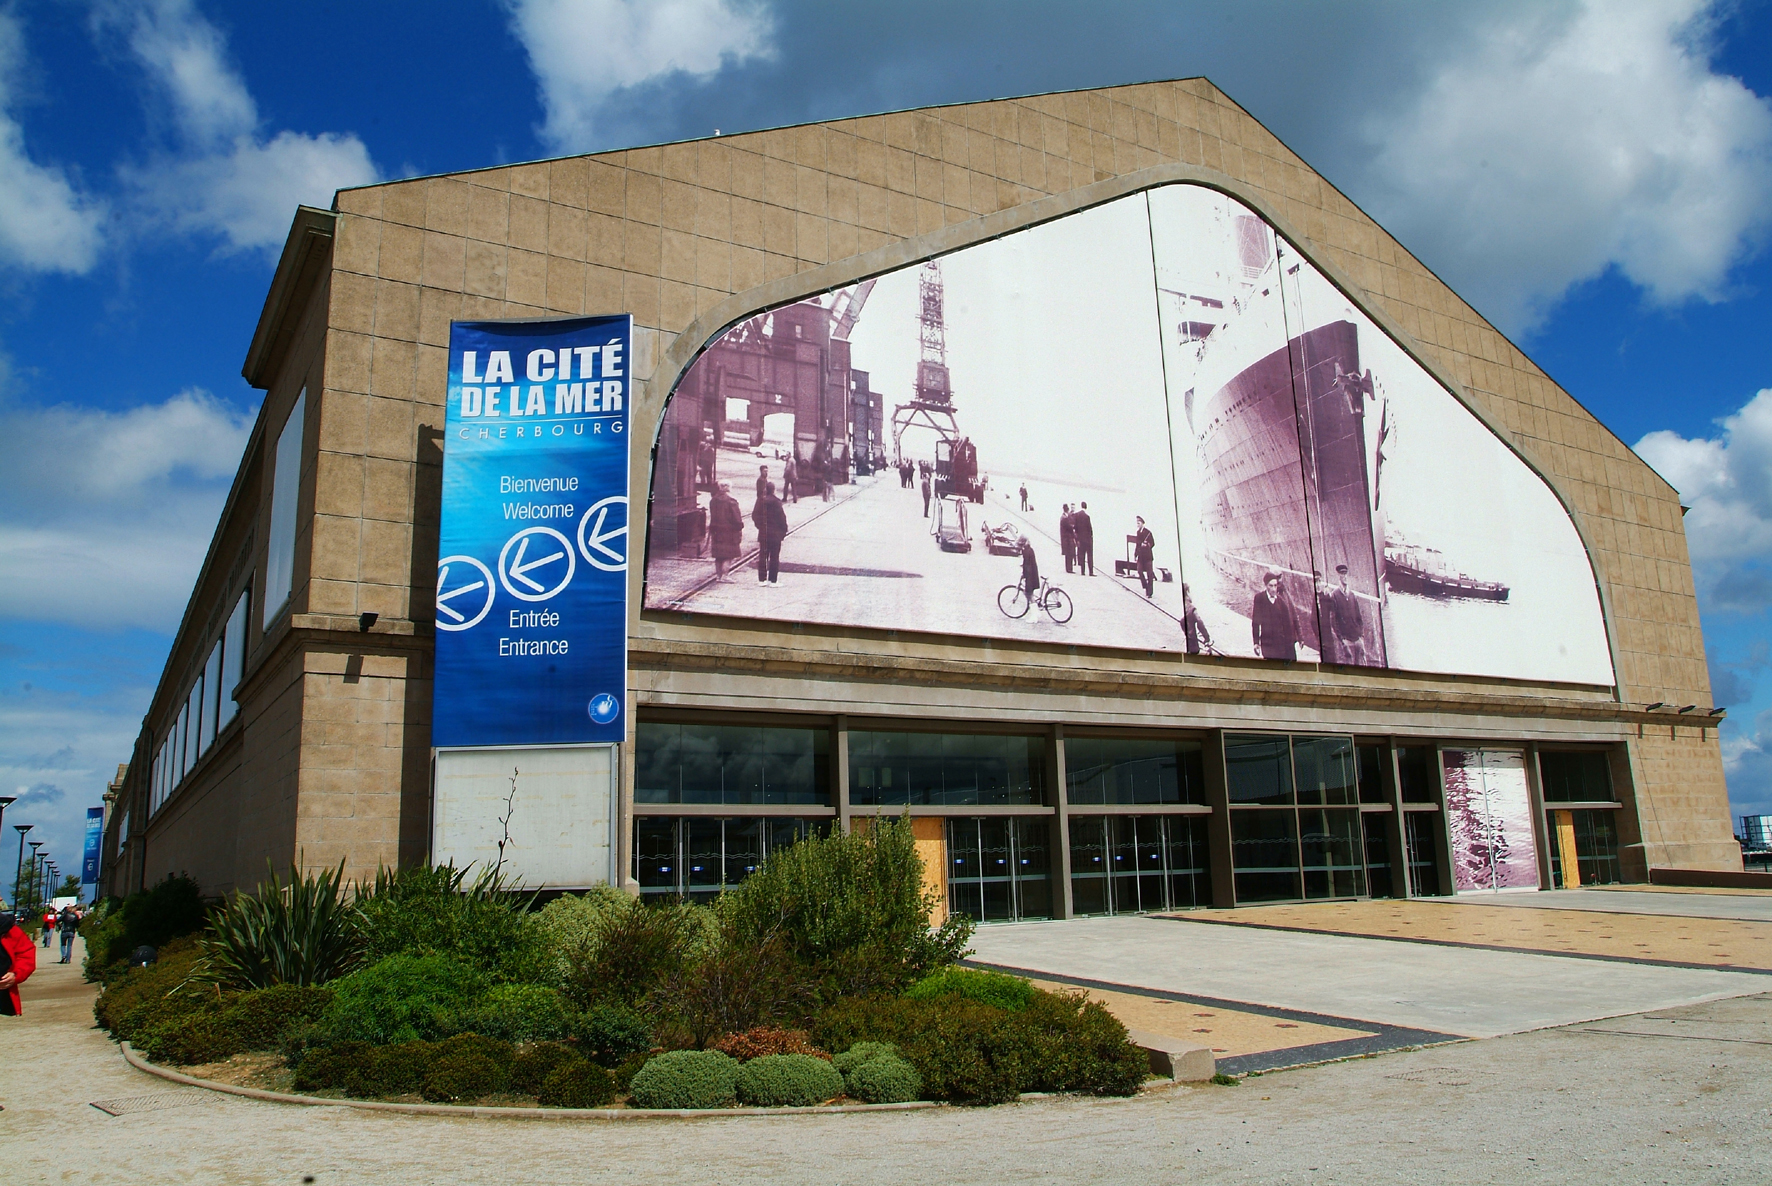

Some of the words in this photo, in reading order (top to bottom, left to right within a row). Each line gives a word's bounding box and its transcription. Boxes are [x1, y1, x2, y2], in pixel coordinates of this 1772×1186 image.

[462, 351, 514, 383] LA
[526, 338, 623, 382] CITÉ
[460, 386, 501, 417] DE
[509, 385, 546, 417] LA
[555, 380, 623, 415] MER
[459, 421, 623, 440] CHERBOURG
[500, 475, 578, 494] Bienvenue
[503, 502, 574, 519] Welcome
[509, 608, 560, 628] Entrée
[499, 637, 568, 656] Entrance
